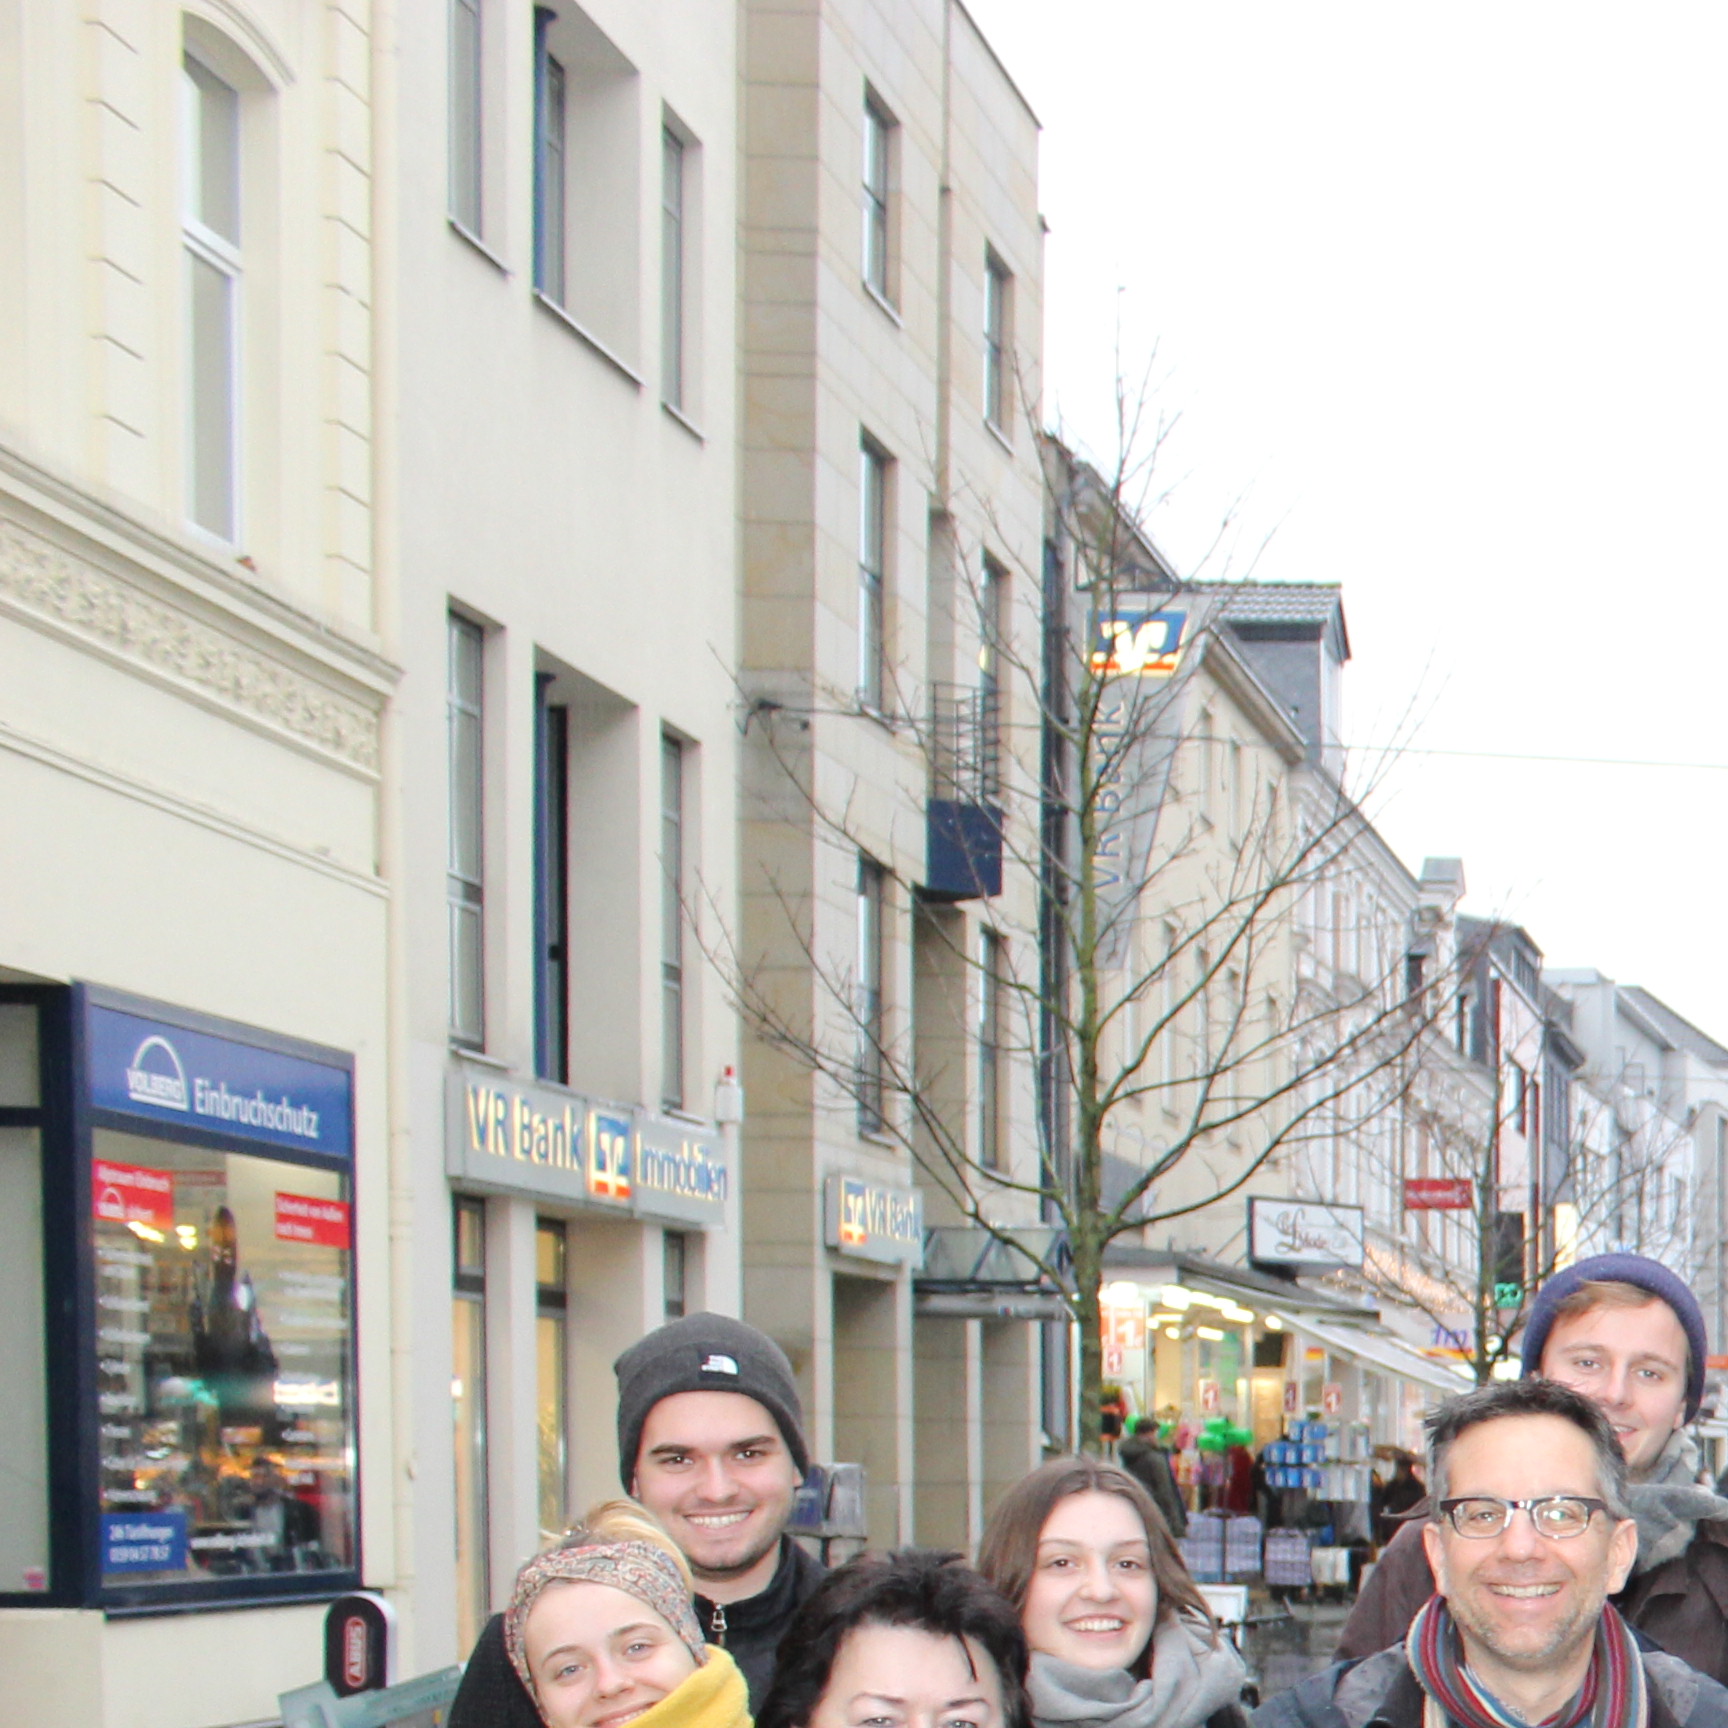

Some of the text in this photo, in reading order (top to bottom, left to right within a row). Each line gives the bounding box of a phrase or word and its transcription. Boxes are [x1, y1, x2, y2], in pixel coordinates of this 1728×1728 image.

[194, 1077, 319, 1139] Einbruchschutz
[466, 1083, 584, 1171] VR Bank
[634, 1131, 728, 1202] Immobilien
[350, 1623, 362, 1679] ABUS
